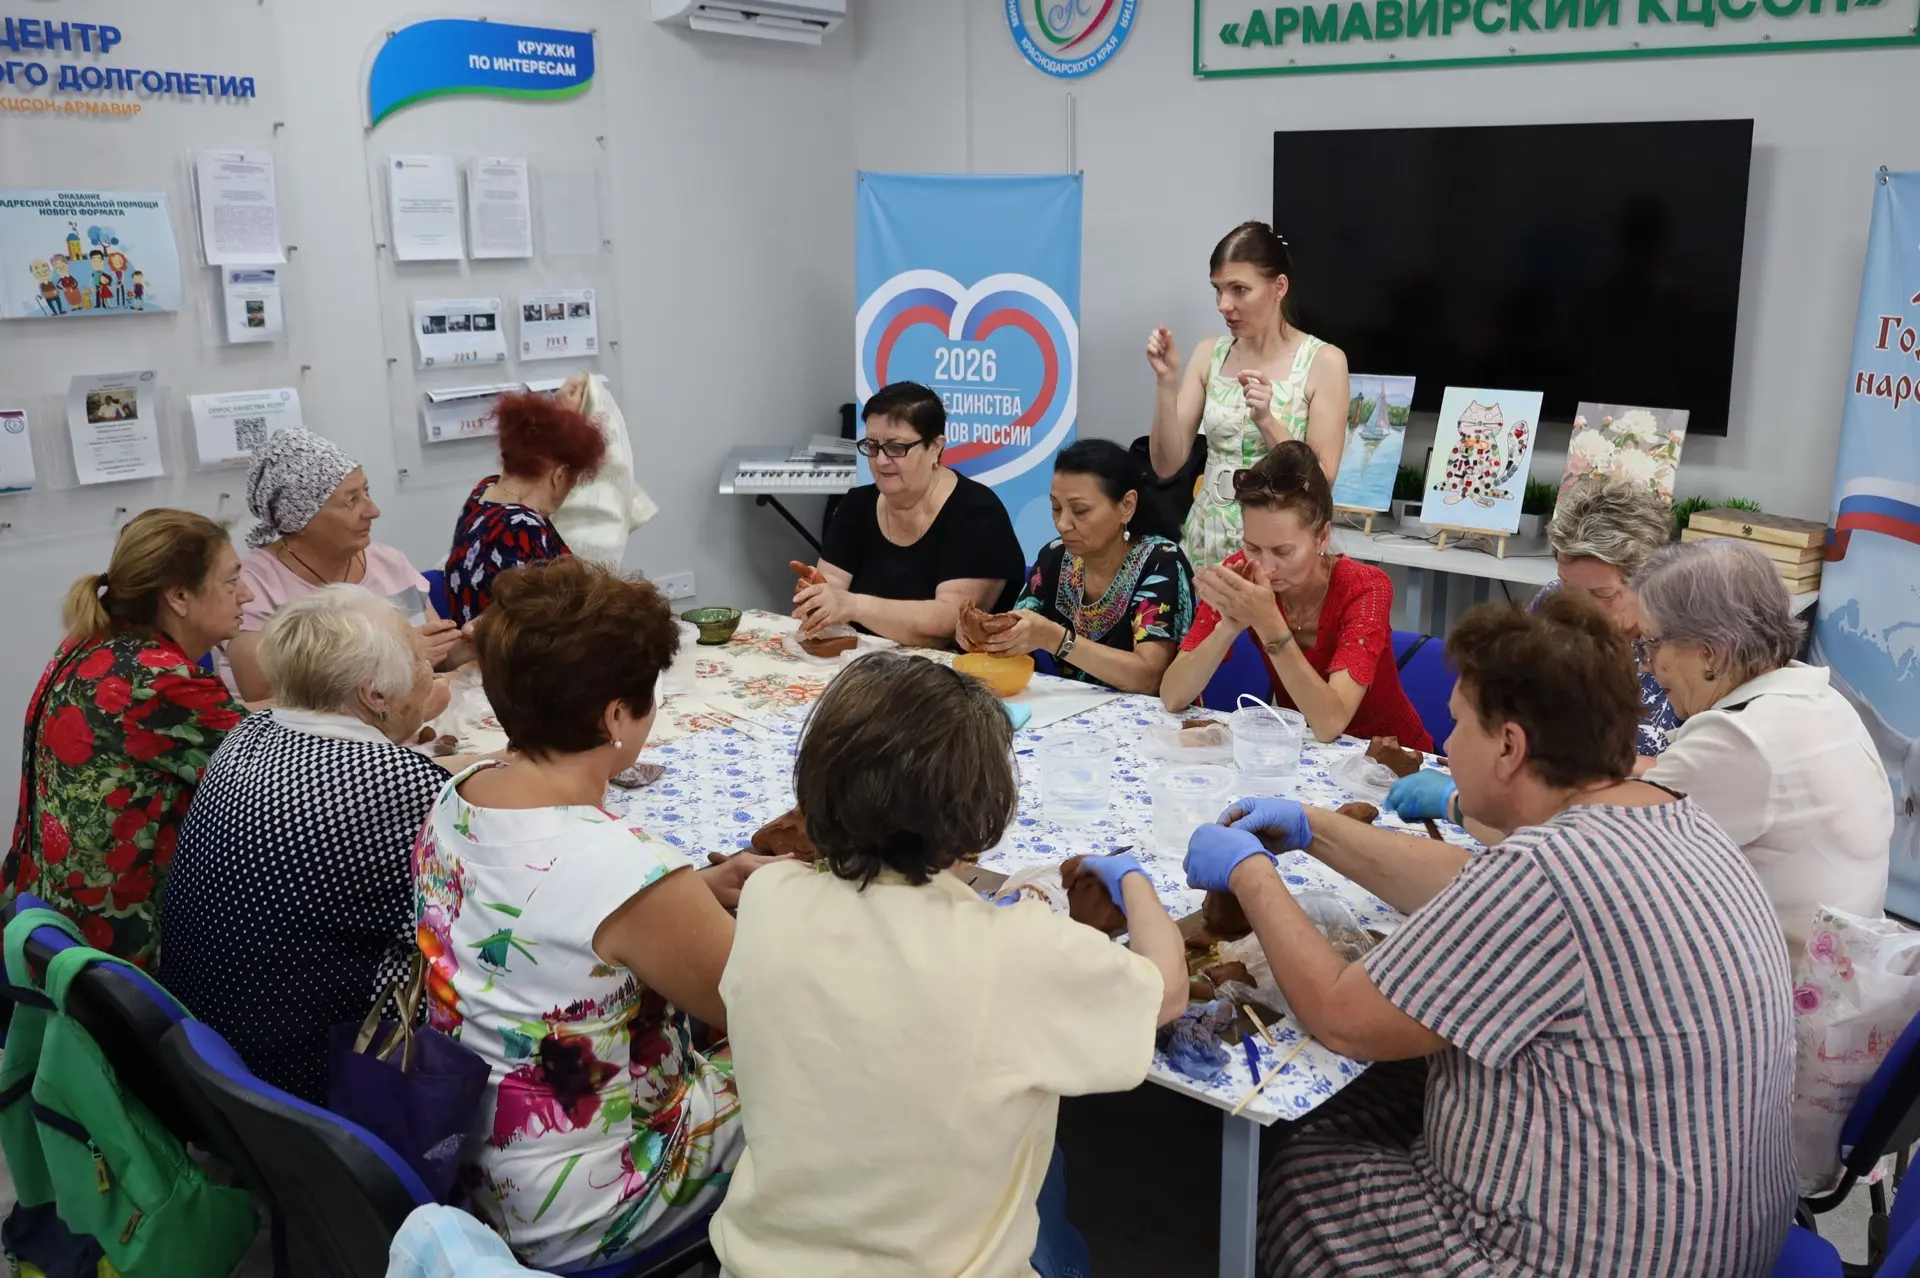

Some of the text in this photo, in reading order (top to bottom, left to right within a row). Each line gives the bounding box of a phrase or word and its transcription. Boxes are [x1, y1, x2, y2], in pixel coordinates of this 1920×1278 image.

[517, 39, 576, 59] КРУЖКИ
[1020, 35, 1119, 74] КРАСНОДАРСКОГО КРАЯ
[468, 54, 577, 76] ПО ИНТЕРЕСАМ
[0, 61, 256, 98] ГО ДОЛГОЛЕТИЯ
[0, 199, 159, 209] АДРЕСНОЙ СОЦИАЛЬНОЙ ПОМОЩИ
[39, 208, 126, 217] НОВОГО ФОРМАТА
[1874, 315, 1920, 362] Го
[934, 347, 997, 382] 2026
[942, 392, 1022, 416] ЕДИНСТВА
[973, 423, 1032, 446] РОССИИ
